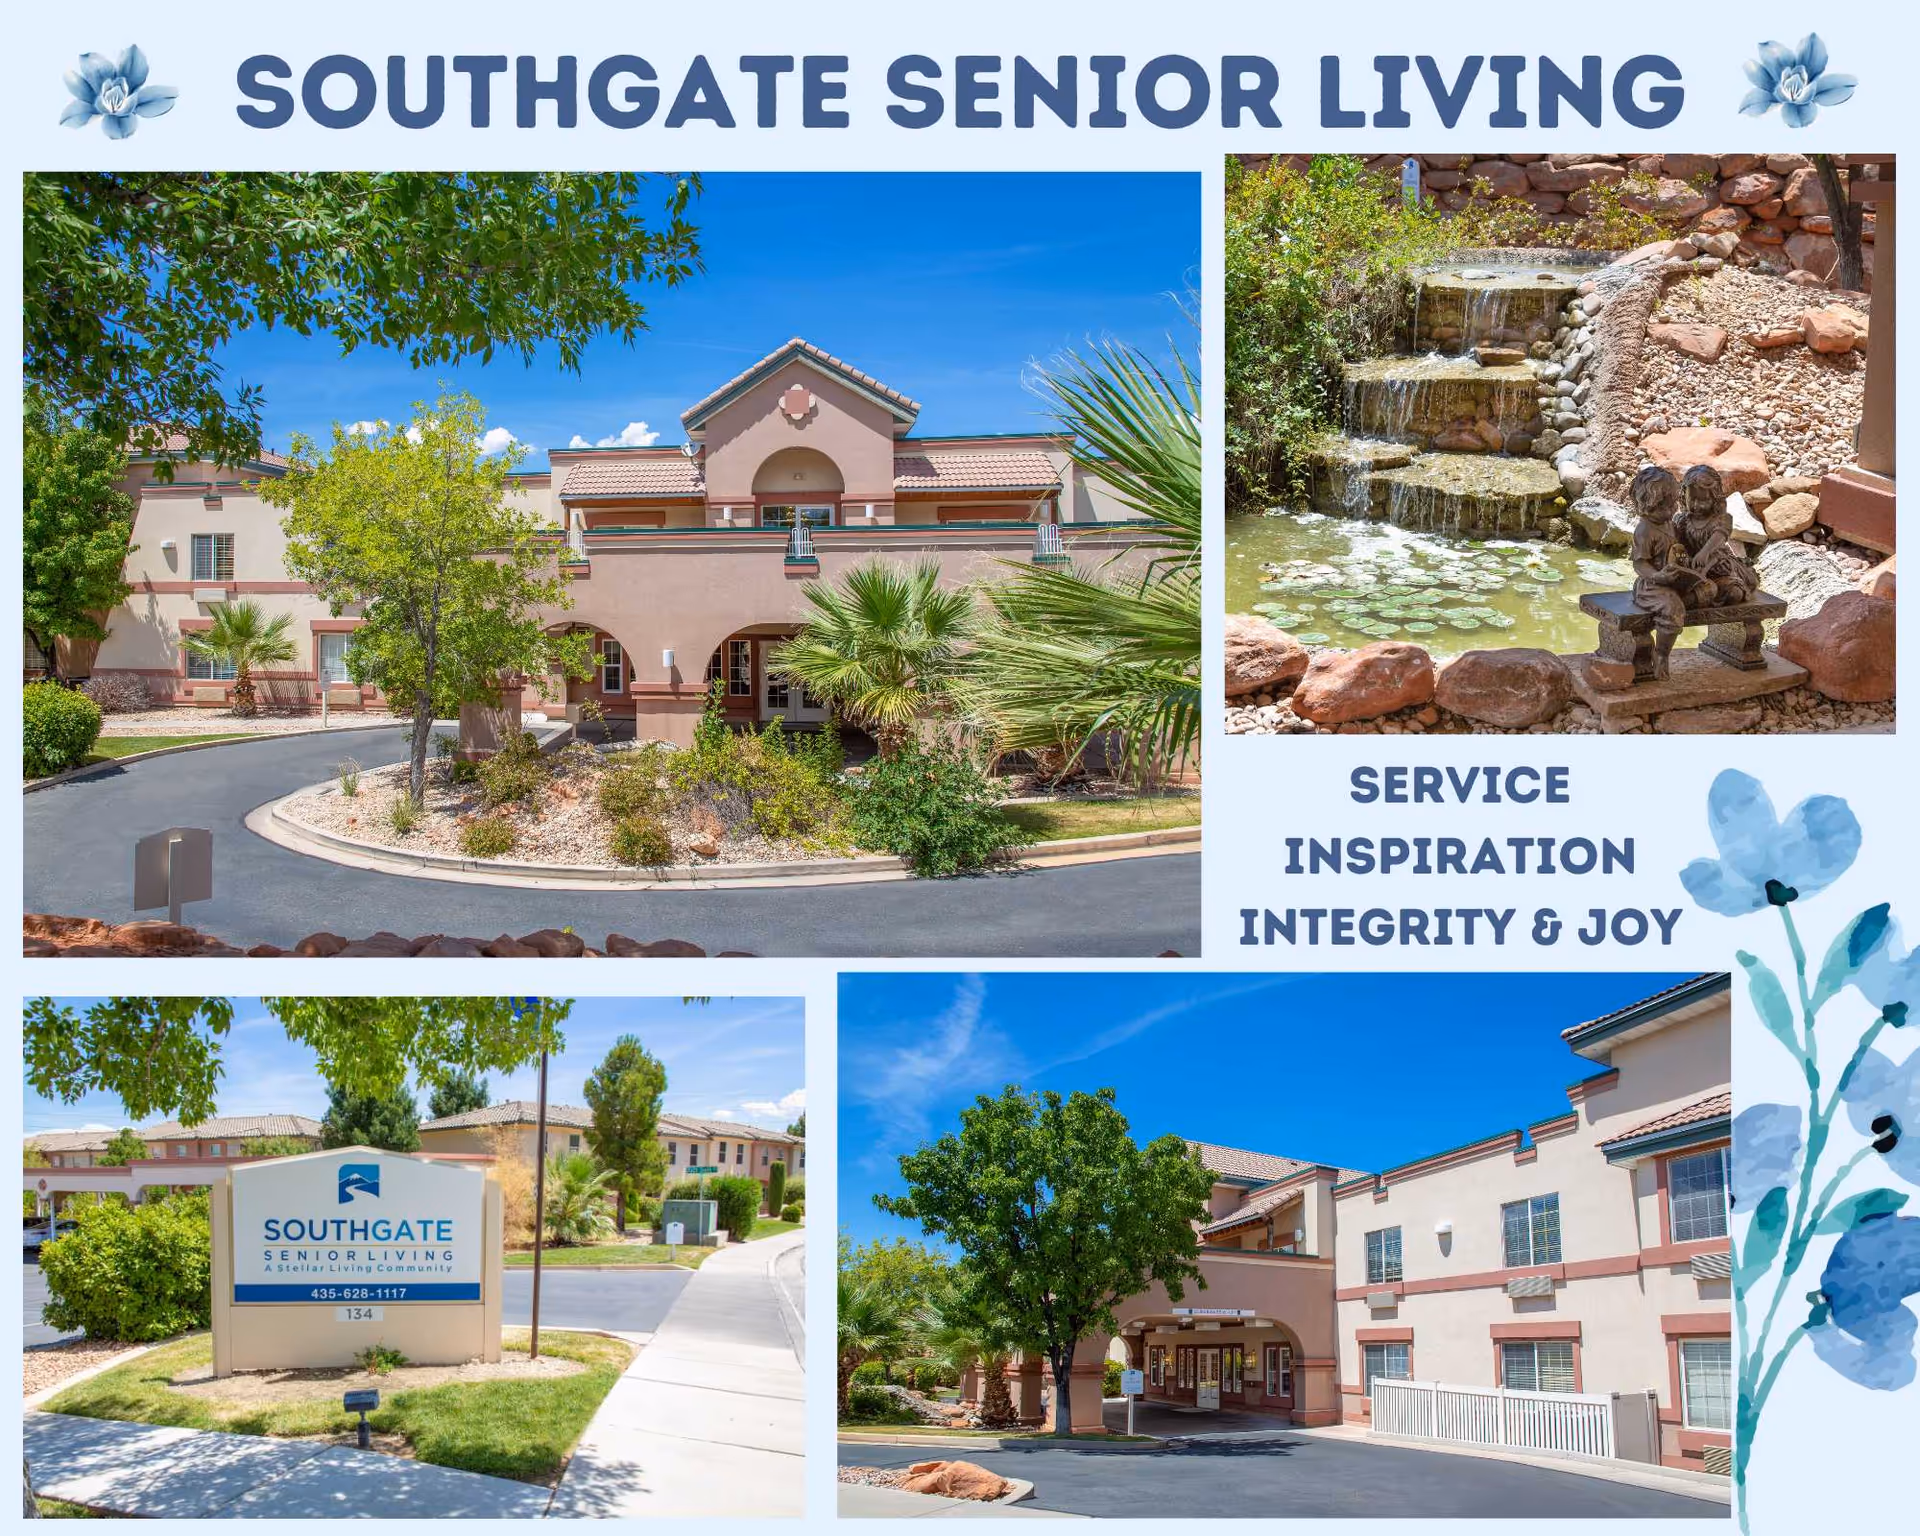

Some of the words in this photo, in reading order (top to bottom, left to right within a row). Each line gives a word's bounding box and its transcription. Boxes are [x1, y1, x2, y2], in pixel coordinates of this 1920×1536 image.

[264, 1219, 453, 1242] SOUTHGATE
[264, 1250, 356, 1261] SENIOR
[368, 1250, 453, 1261] LIVING
[264, 1264, 272, 1273] A
[277, 1263, 325, 1273] Stellar
[329, 1263, 372, 1274] Living
[377, 1263, 453, 1274] Community
[311, 1288, 407, 1299] 435-628-1117
[346, 1308, 373, 1320] 134
